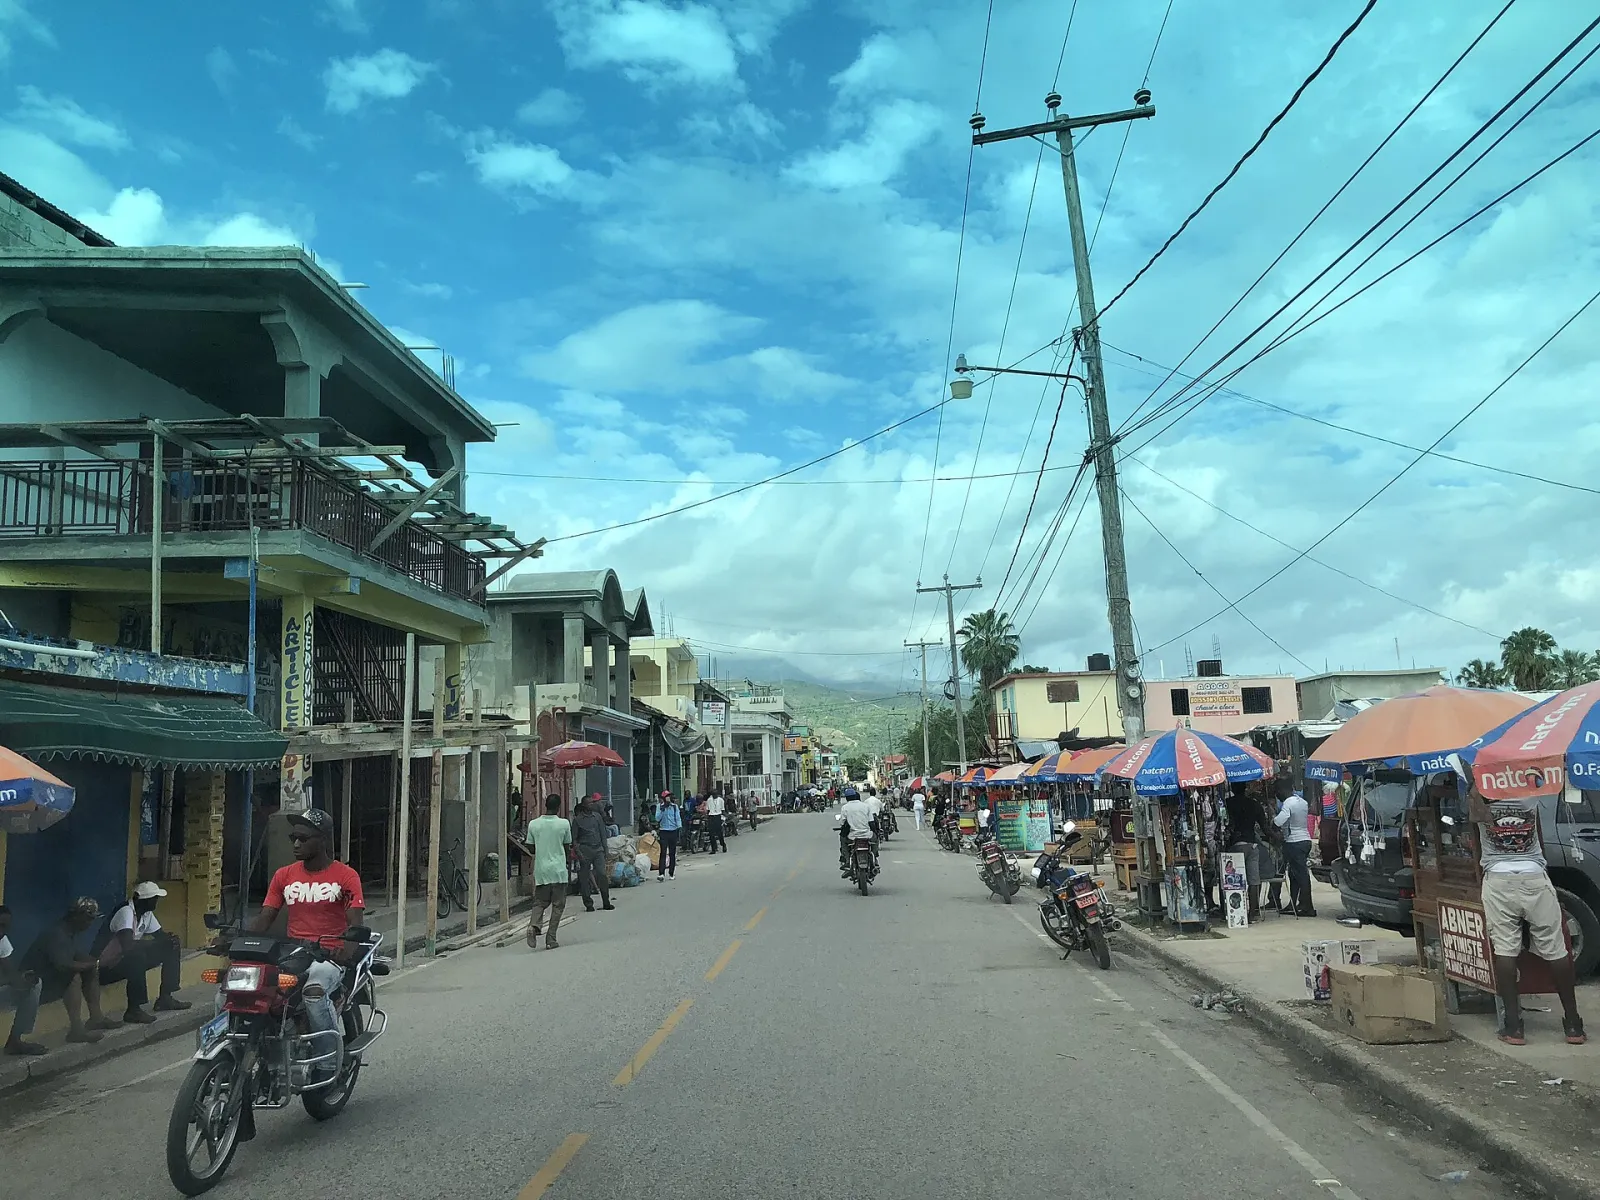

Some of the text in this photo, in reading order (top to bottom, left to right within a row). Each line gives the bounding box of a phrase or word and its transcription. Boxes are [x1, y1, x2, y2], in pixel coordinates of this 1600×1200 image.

[446, 673, 460, 720] CIM
[1519, 692, 1587, 751] natcom
[1119, 742, 1150, 775] natcom
[1185, 738, 1204, 770] natcom
[1221, 753, 1250, 763] natcom
[1422, 755, 1451, 771] natc
[1142, 766, 1174, 775] natcom
[1181, 771, 1225, 788] natcom
[1311, 766, 1338, 779] natcom
[1481, 765, 1563, 790] natcom
[1573, 762, 1600, 776] 0.Fa
[1441, 906, 1485, 940] ABNER
[1443, 933, 1484, 958] OPTIMISTE
